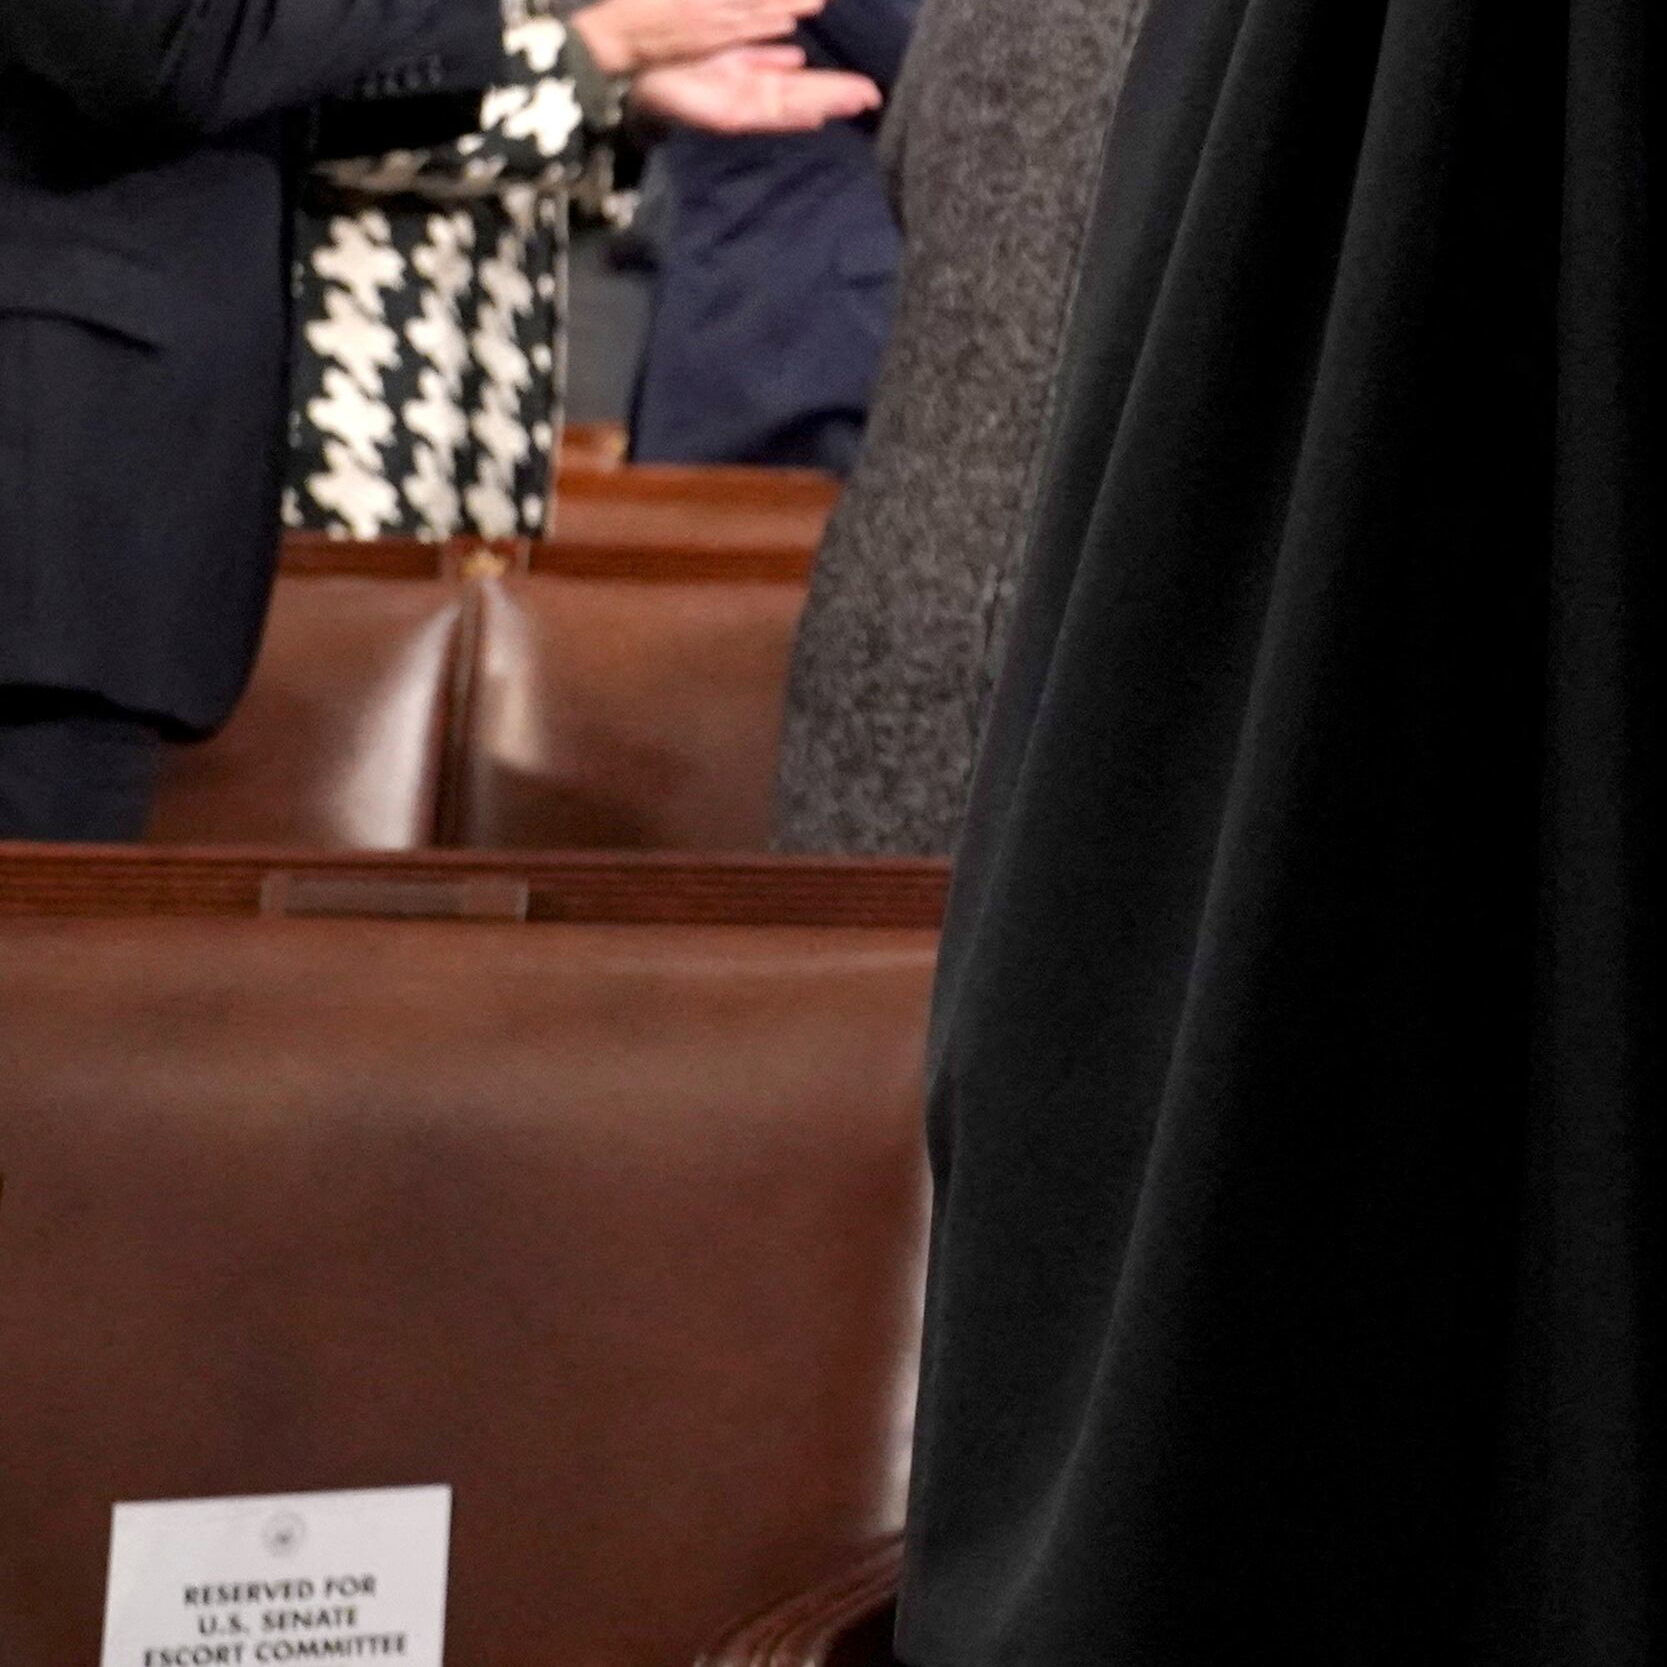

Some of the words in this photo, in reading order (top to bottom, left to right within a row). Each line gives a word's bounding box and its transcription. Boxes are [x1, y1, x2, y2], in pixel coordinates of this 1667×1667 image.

[184, 1580, 315, 1606] RESERVED
[324, 1574, 377, 1599] FOR
[199, 1612, 250, 1635] U.S.
[263, 1607, 356, 1632] SENATE
[144, 1643, 242, 1667] ESCORT
[255, 1633, 406, 1662] COMMITTEE
